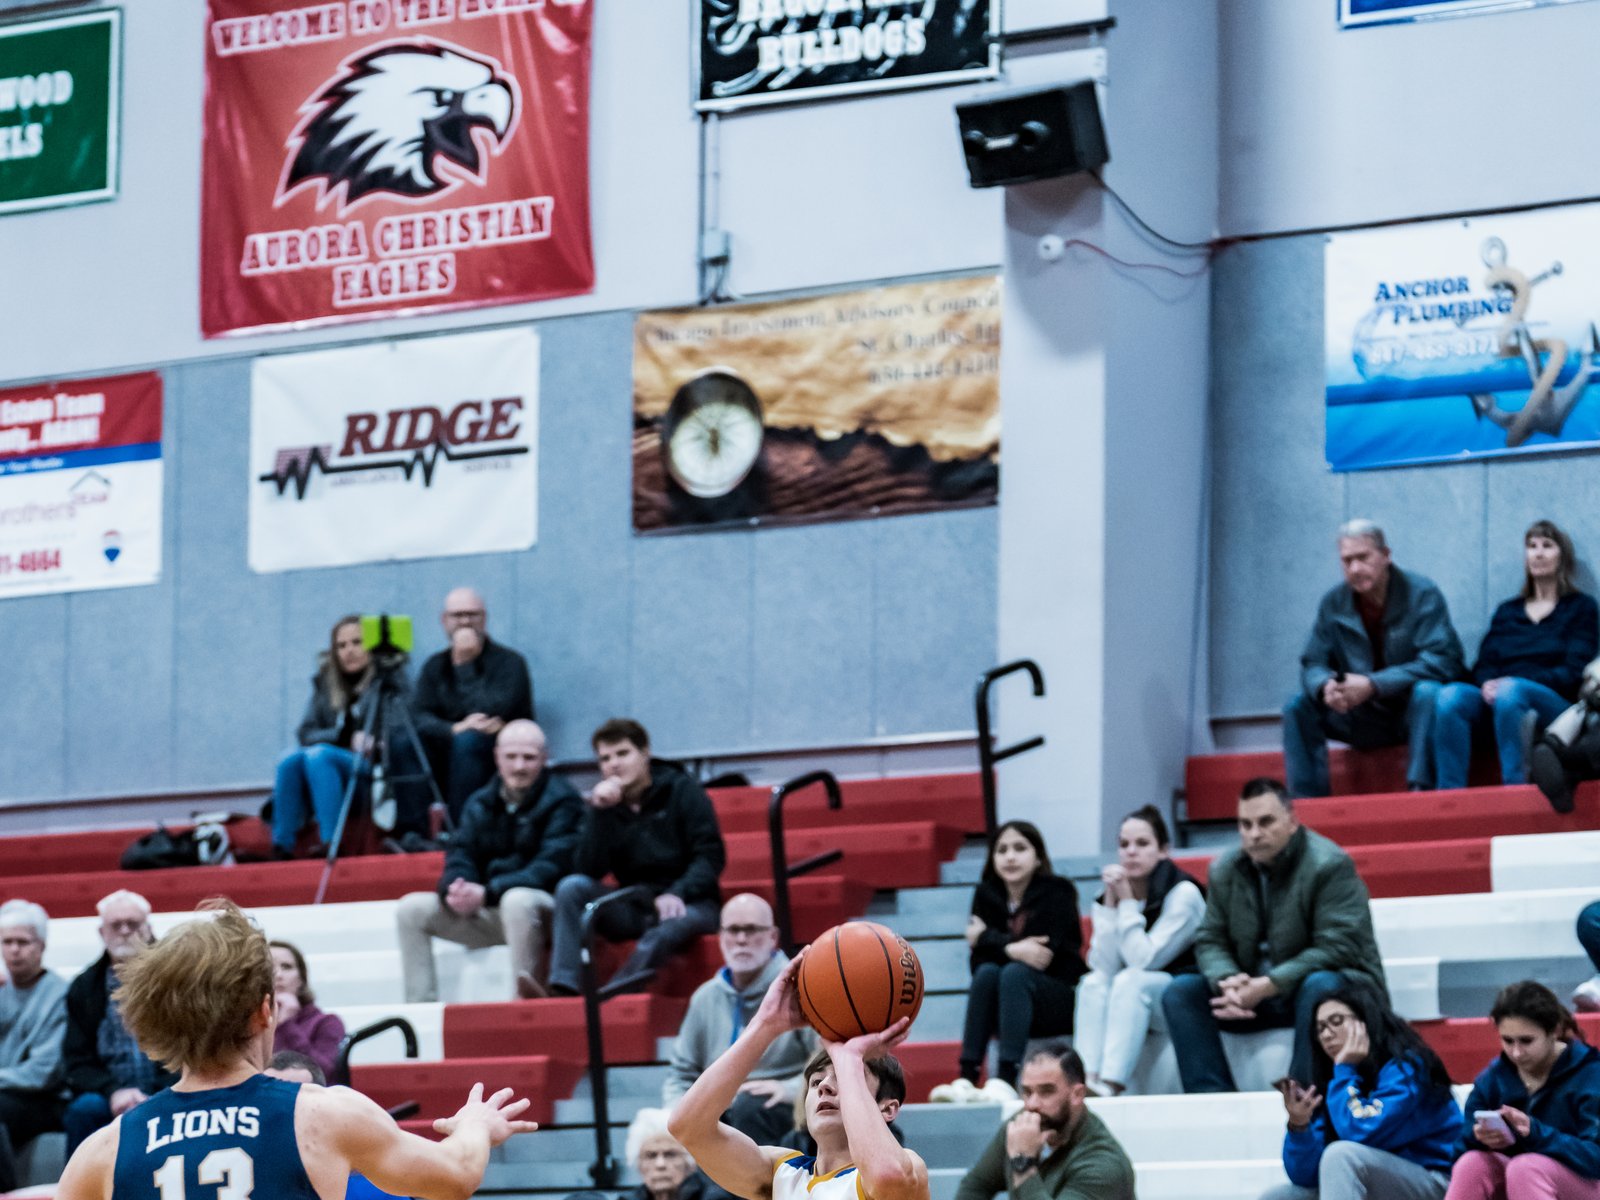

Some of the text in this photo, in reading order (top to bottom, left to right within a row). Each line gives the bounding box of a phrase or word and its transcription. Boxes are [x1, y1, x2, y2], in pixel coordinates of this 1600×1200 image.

[214, 8, 345, 54] WELCOME
[351, 0, 390, 34] TO
[758, 18, 926, 72] BULLDOGS
[244, 199, 551, 273] AURORA CHRISTIAN
[336, 256, 454, 305] EAGLES
[1375, 276, 1470, 301] ANCHOR
[1394, 297, 1513, 324] PLUMBING
[339, 396, 523, 457] RIDGE
[146, 1106, 260, 1155] LIONS
